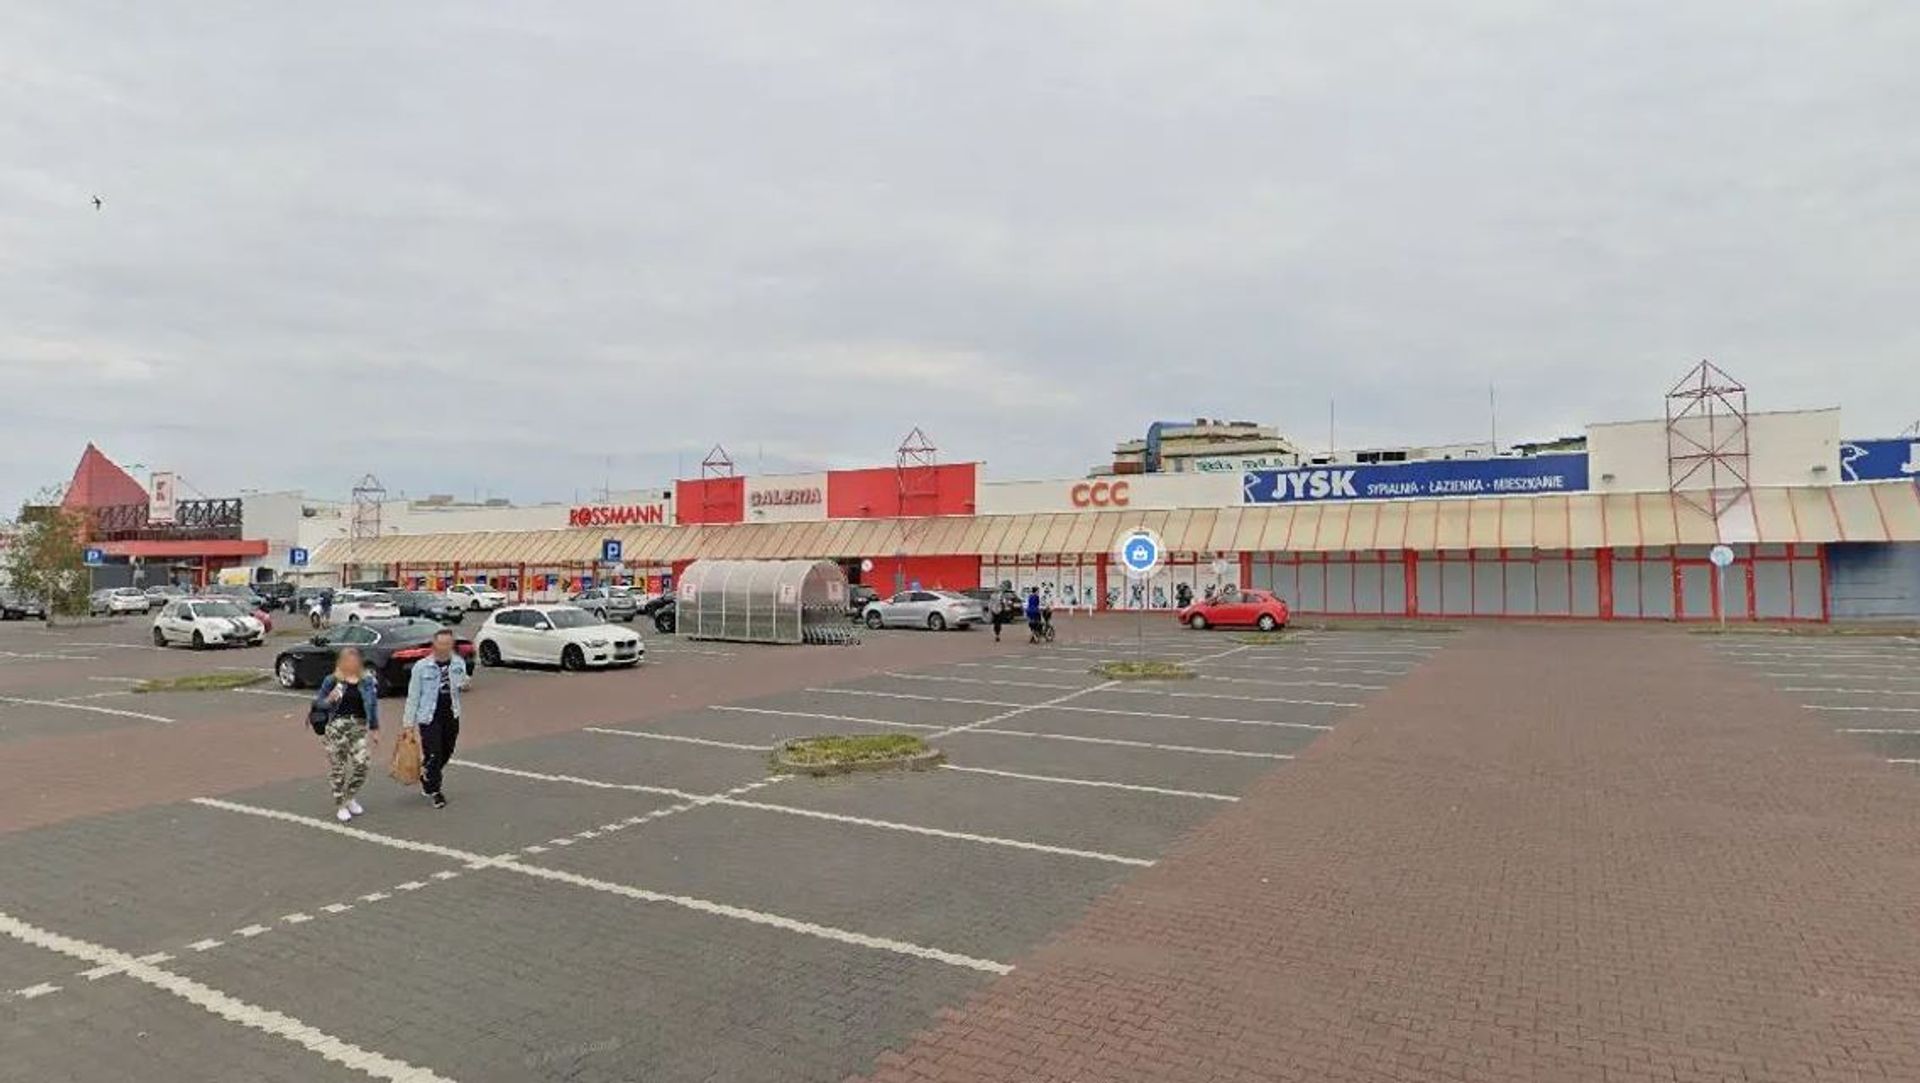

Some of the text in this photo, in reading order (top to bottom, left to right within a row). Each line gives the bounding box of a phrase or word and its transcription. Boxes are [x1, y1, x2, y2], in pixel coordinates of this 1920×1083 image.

[1071, 481, 1130, 507] CCC
[1271, 470, 1358, 499] JYSK
[1367, 475, 1564, 495] SYPIALNIA ŁAZIENKA MIESZKANIE
[751, 487, 822, 507] GALERIA
[569, 504, 663, 527] ROSSMANN
